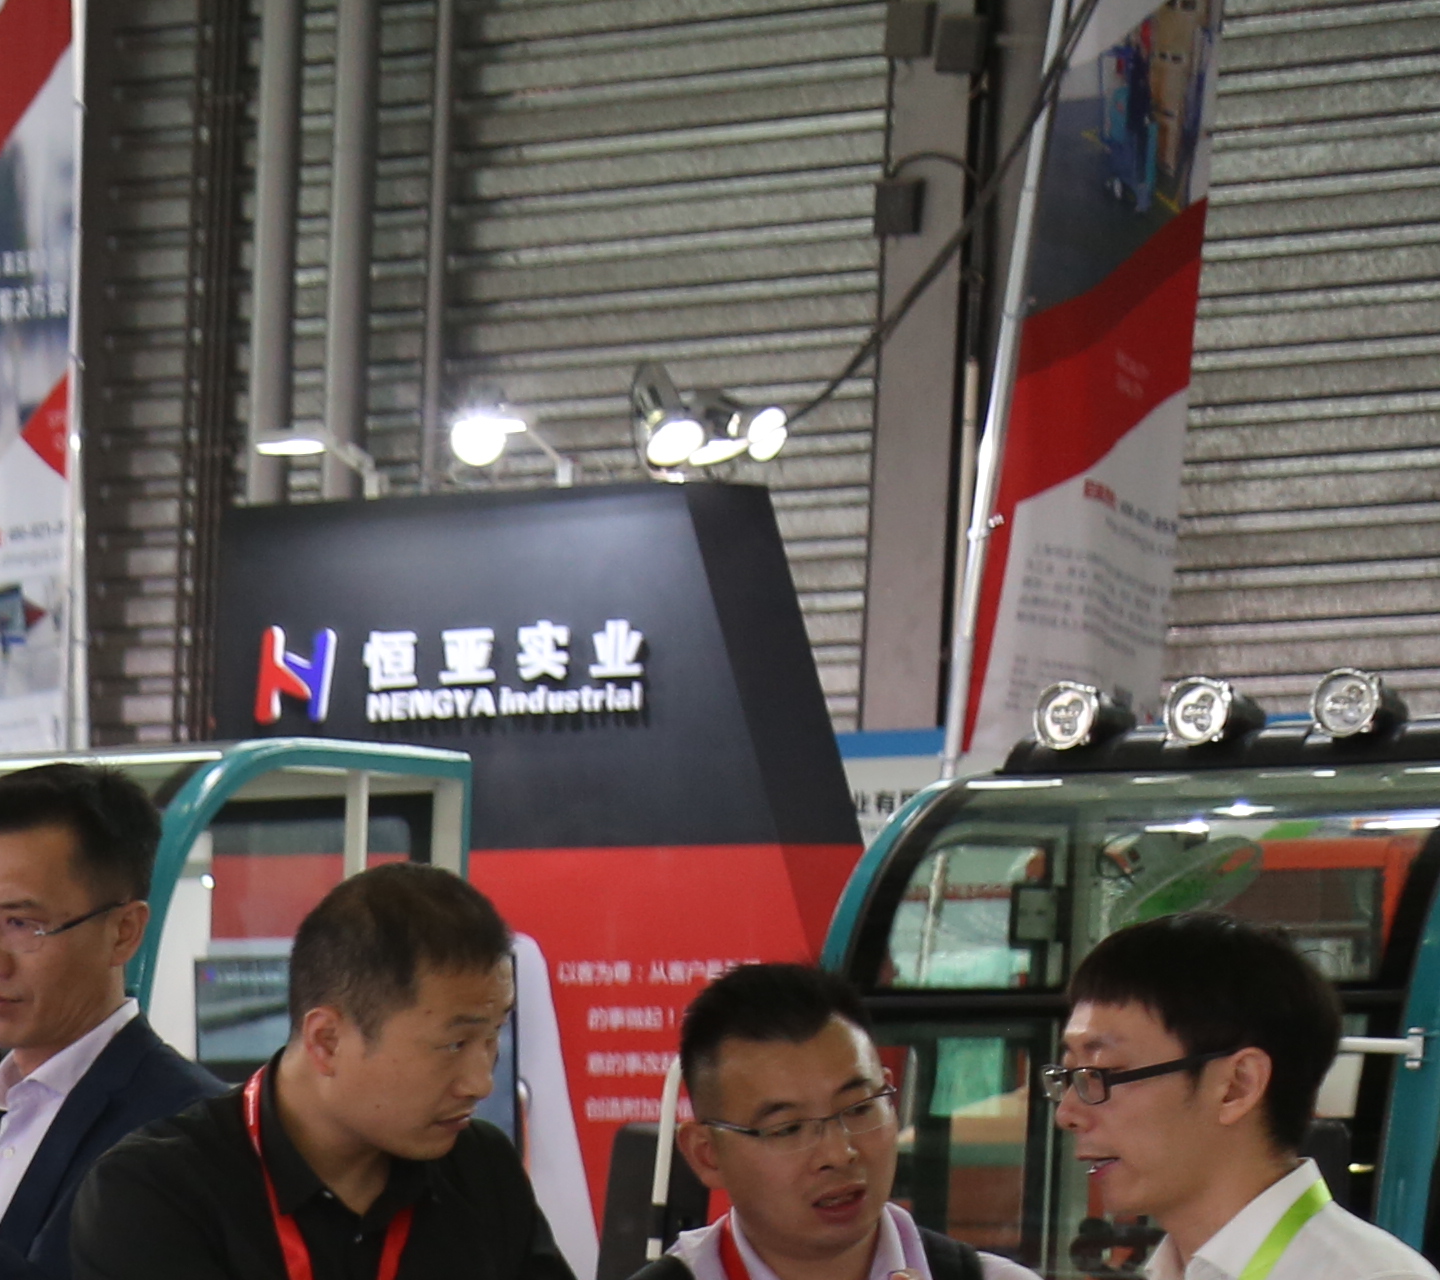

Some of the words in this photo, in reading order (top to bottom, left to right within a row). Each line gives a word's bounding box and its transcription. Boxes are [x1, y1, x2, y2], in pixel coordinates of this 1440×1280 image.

[362, 618, 643, 691] 恒亚实业
[500, 681, 644, 716] industrial
